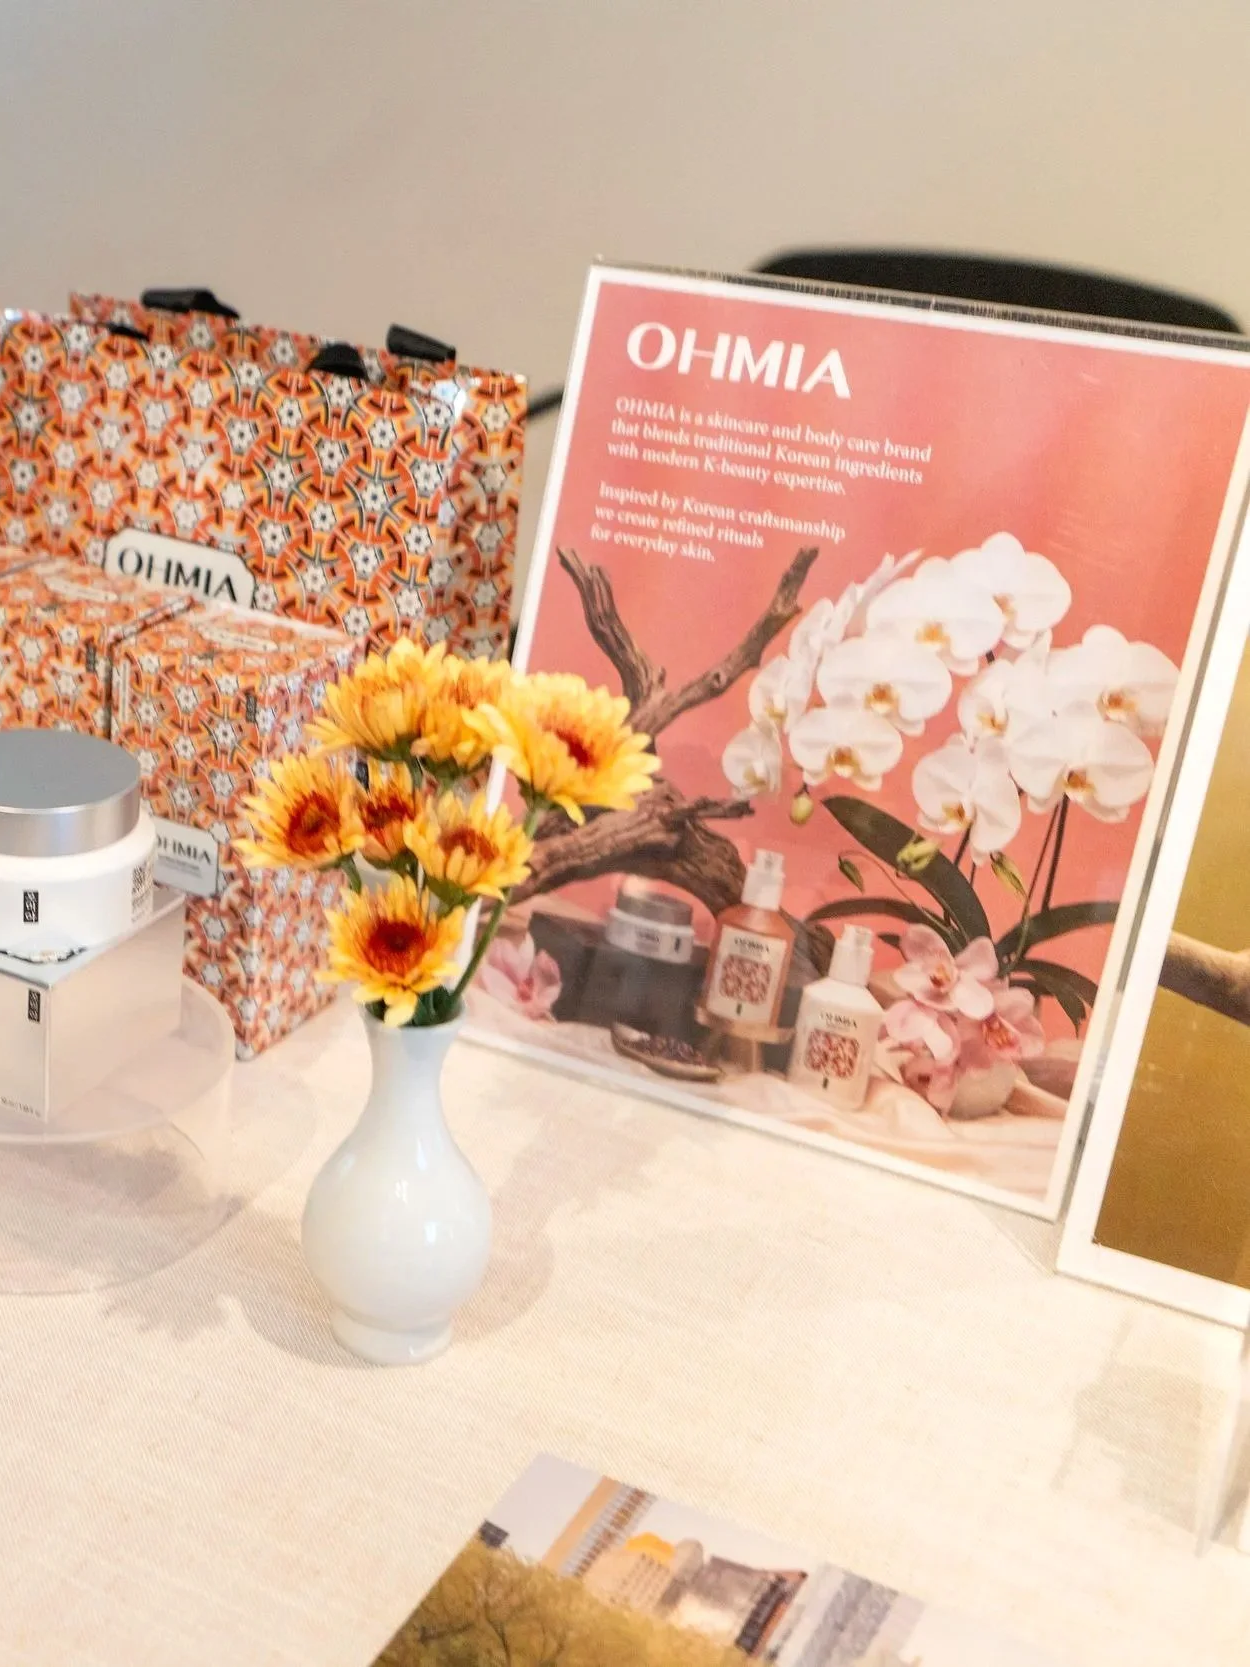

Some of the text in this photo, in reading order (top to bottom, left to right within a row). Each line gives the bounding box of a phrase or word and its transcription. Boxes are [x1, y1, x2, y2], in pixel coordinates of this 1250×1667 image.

[626, 321, 851, 400] OHMIA
[611, 418, 924, 485] that blends traditional Korean ingredients
[615, 396, 932, 463] OHMIA is a skincare and body care brand
[607, 440, 638, 460] with
[642, 447, 699, 470] modern
[704, 454, 770, 486] K-beauty
[590, 522, 611, 542] for
[614, 530, 678, 558] everyday
[595, 504, 764, 549] we create refined rituals
[599, 480, 846, 544] Inspired by Korean craftsmanship
[118, 546, 237, 603] OHMIA
